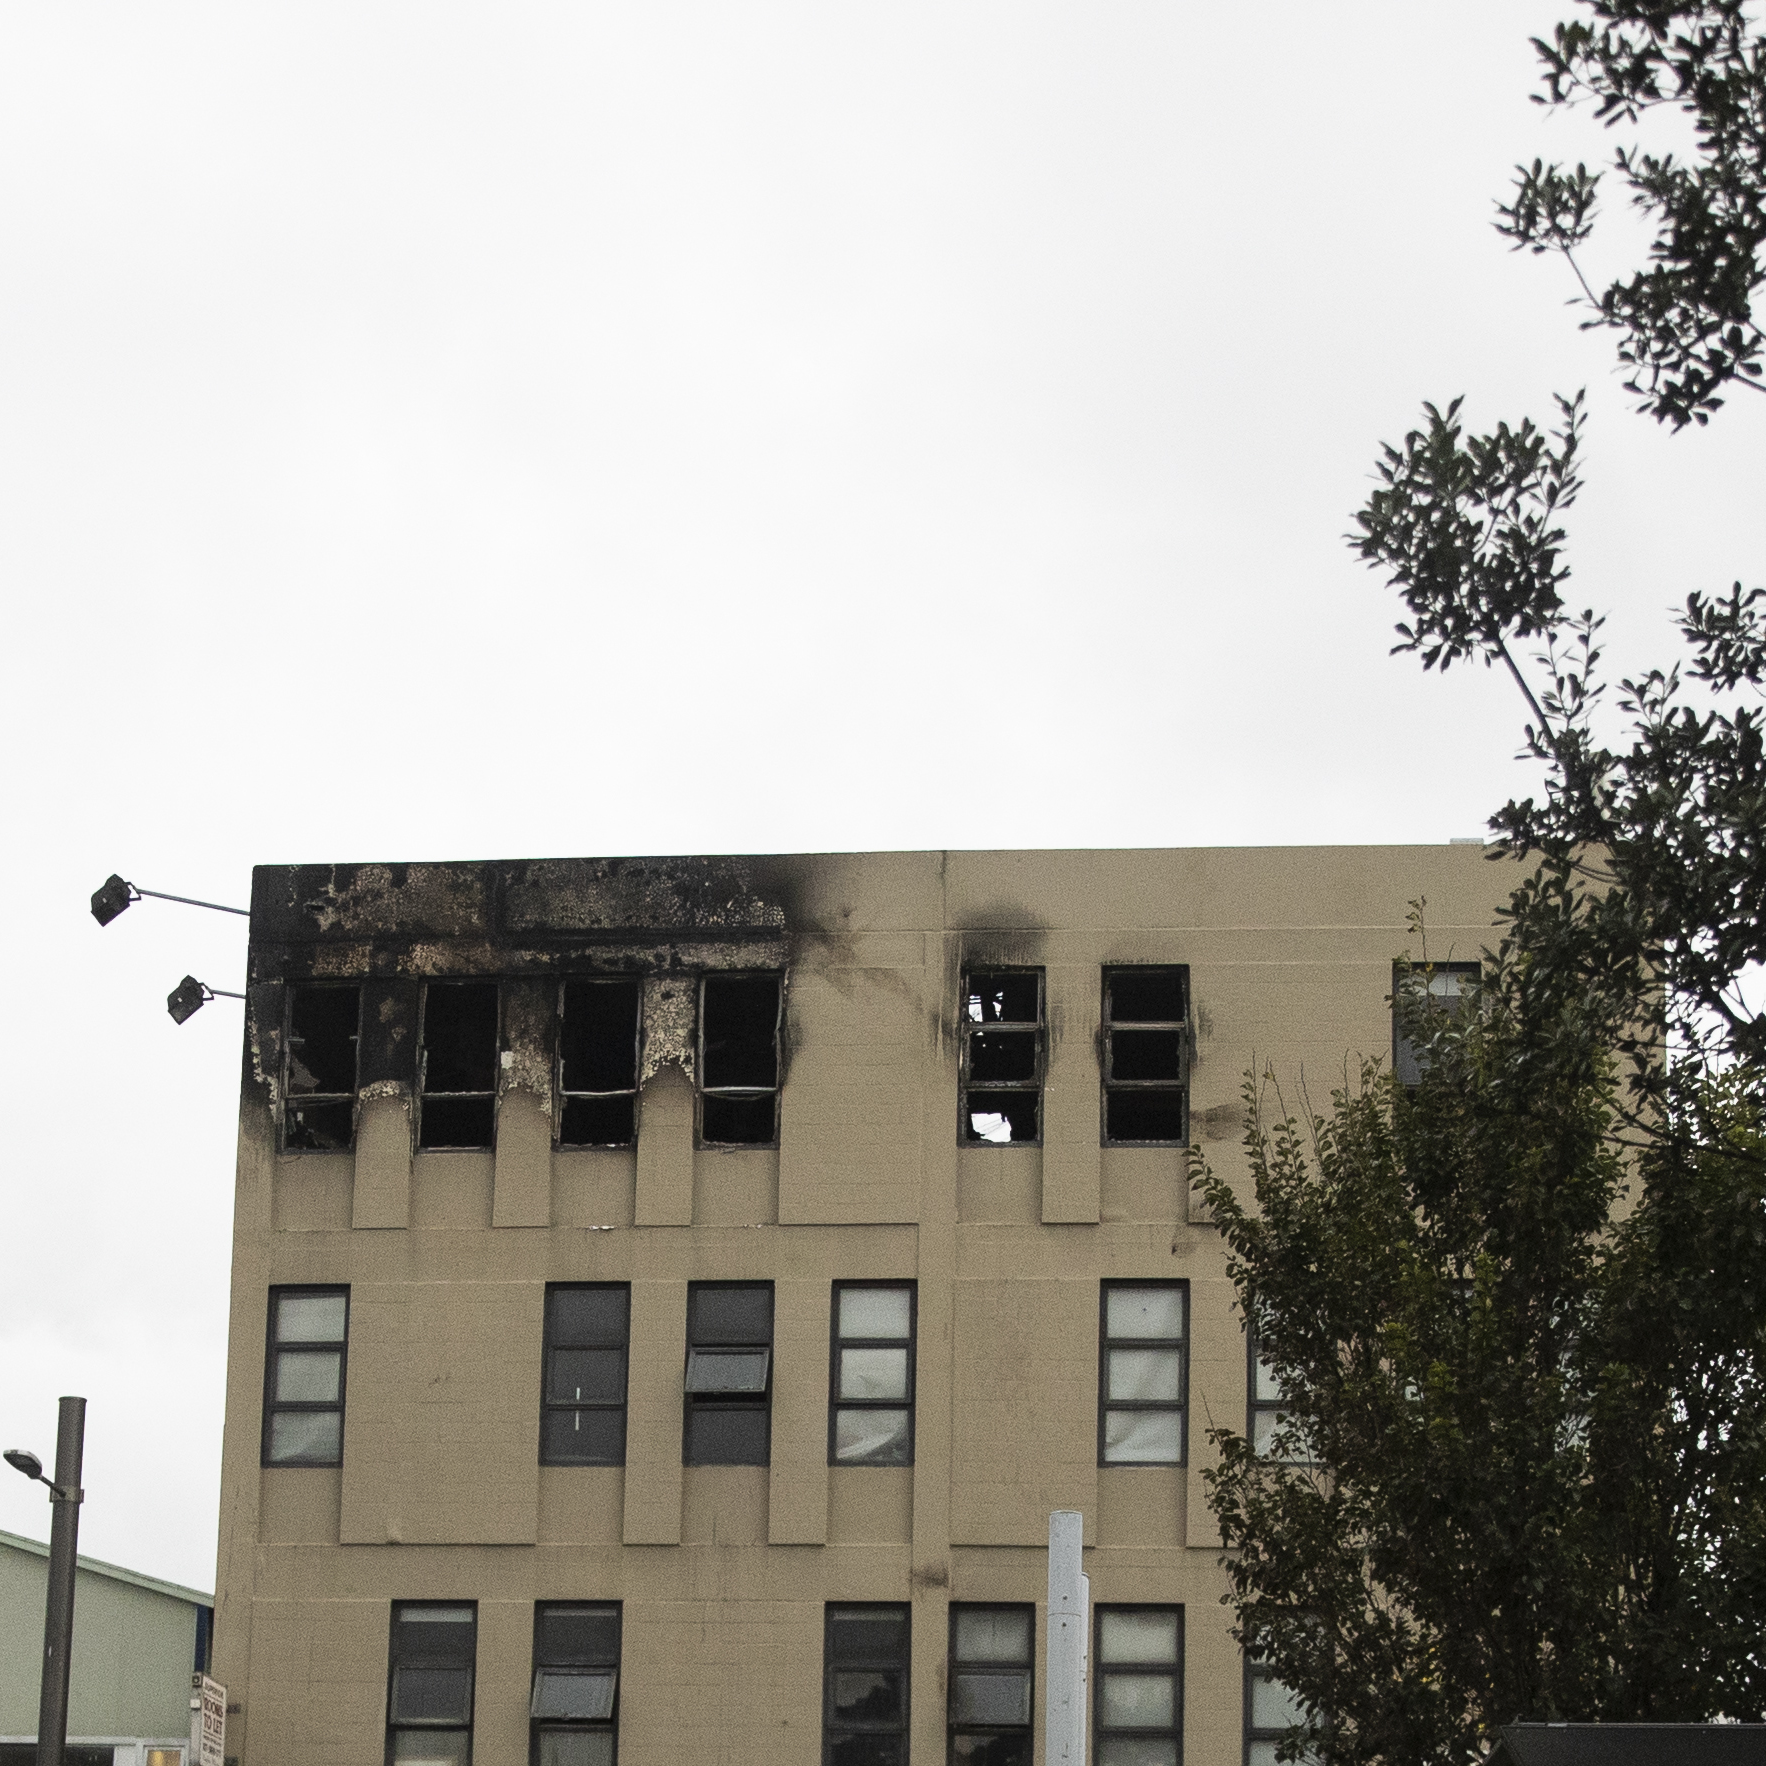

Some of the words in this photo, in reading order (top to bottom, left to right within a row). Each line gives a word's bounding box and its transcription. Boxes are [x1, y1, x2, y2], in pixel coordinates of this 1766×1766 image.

[204, 1696, 223, 1718] ROOMS
[204, 1713, 212, 1729] TO
[213, 1718, 223, 1735] LET
